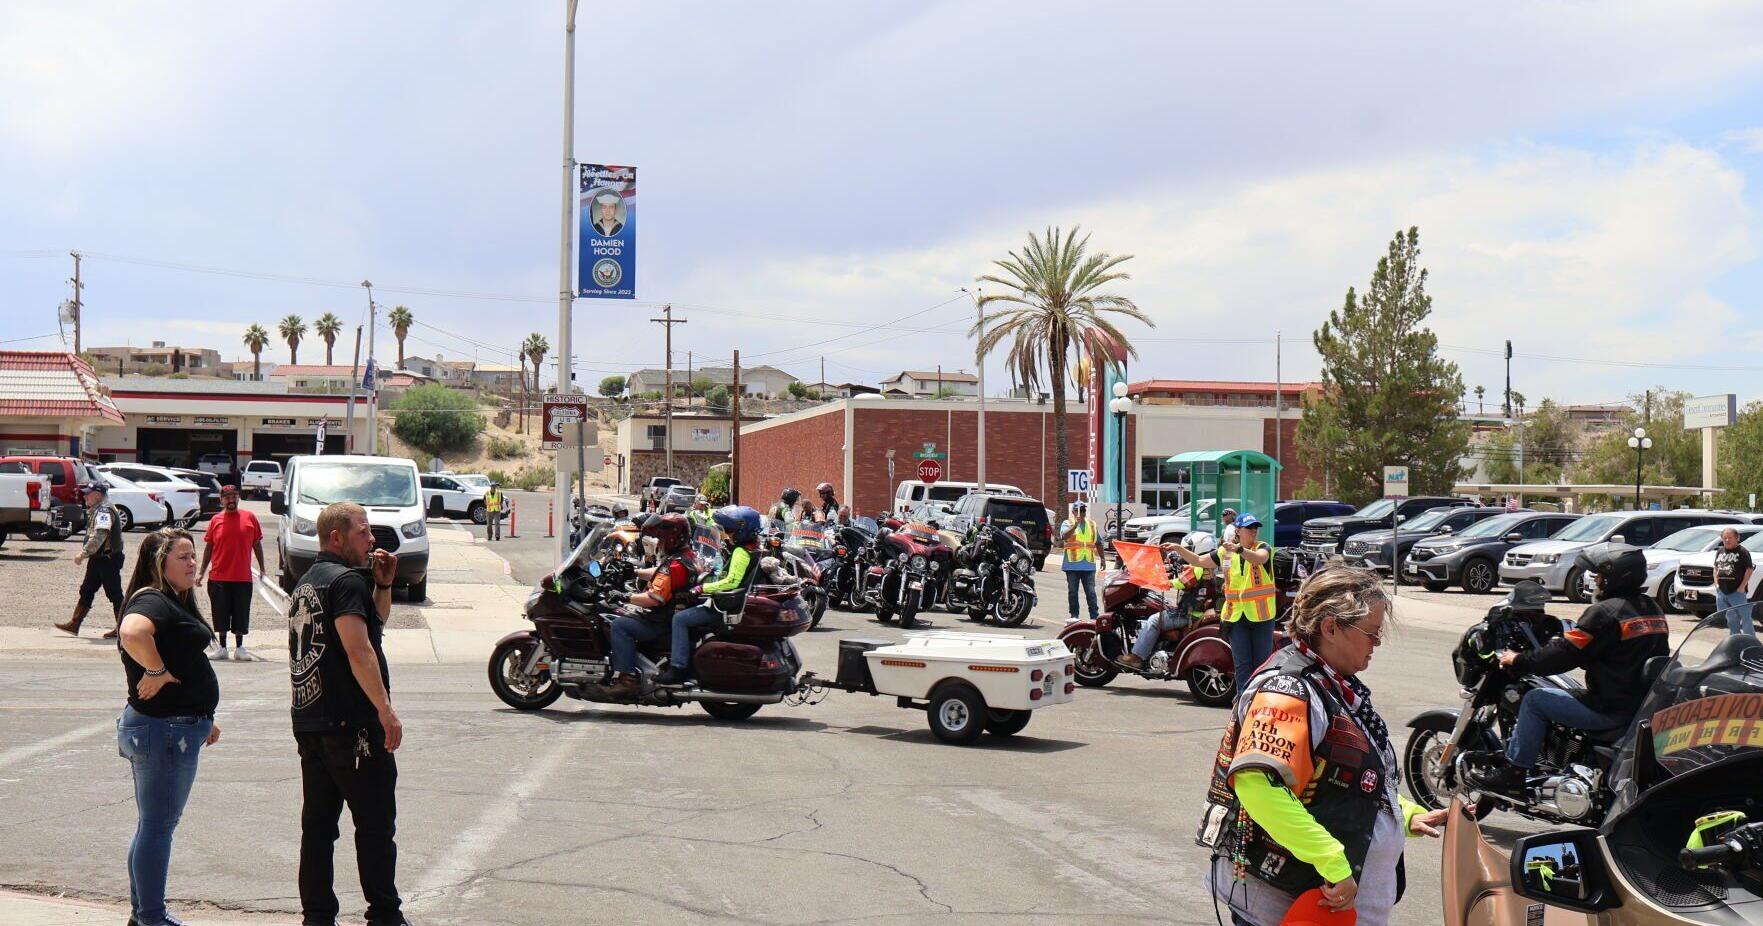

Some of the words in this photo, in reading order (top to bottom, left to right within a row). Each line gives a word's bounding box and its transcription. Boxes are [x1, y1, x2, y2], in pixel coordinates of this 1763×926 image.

[591, 239, 625, 247] DAMIEN
[594, 247, 621, 256] HOOD
[919, 467, 939, 476] STOP
[1070, 471, 1088, 490] TG
[315, 622, 324, 634] M
[1252, 719, 1278, 735] 9th
